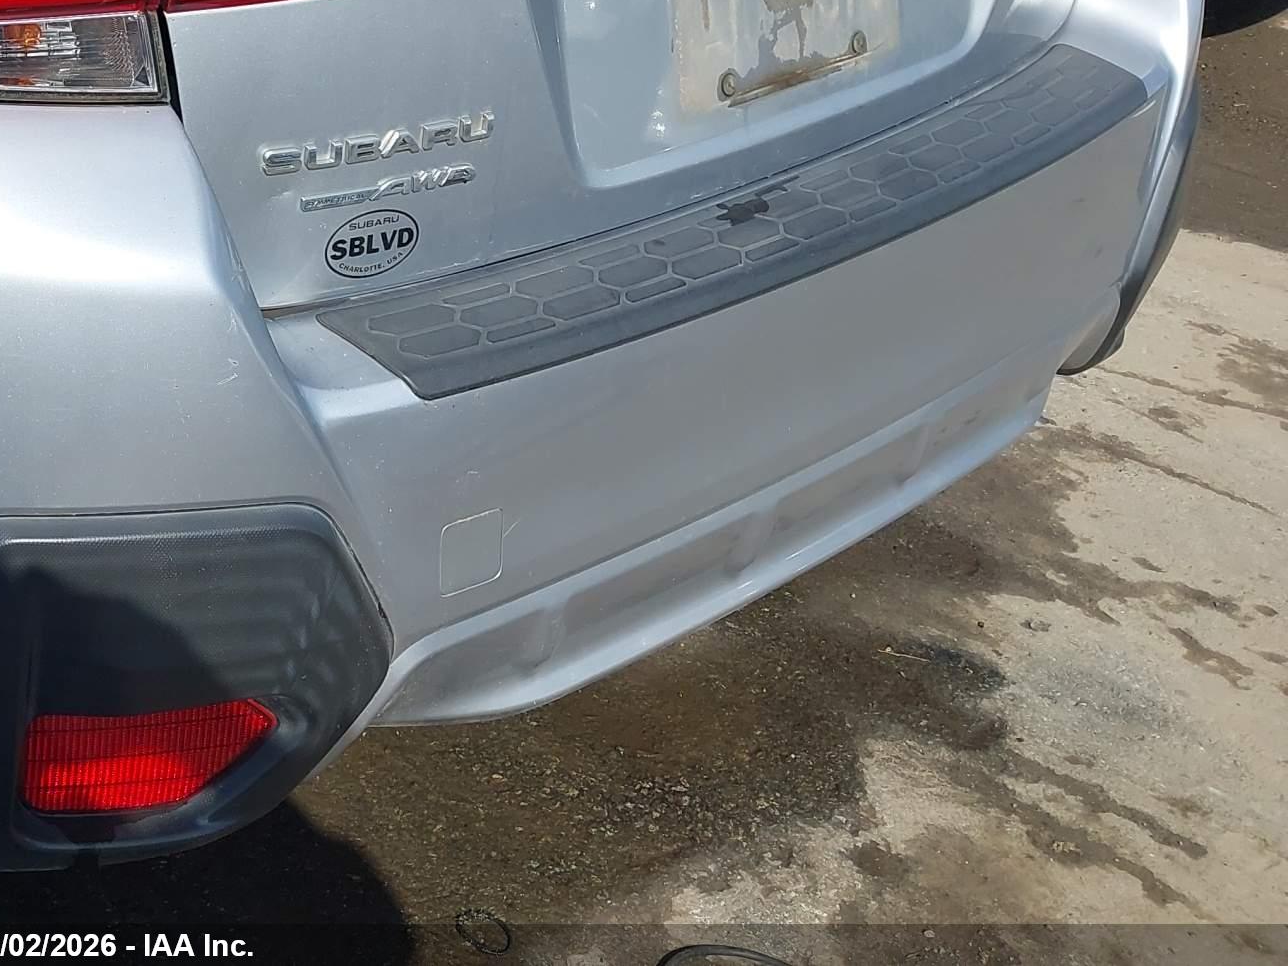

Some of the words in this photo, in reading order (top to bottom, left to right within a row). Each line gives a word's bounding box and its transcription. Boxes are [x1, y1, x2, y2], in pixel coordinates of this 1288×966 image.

[262, 110, 495, 176] SUBARU
[368, 163, 476, 201] AWD
[348, 214, 400, 231] SUBARU
[330, 227, 415, 261] SBLVD
[386, 251, 404, 265] USA
